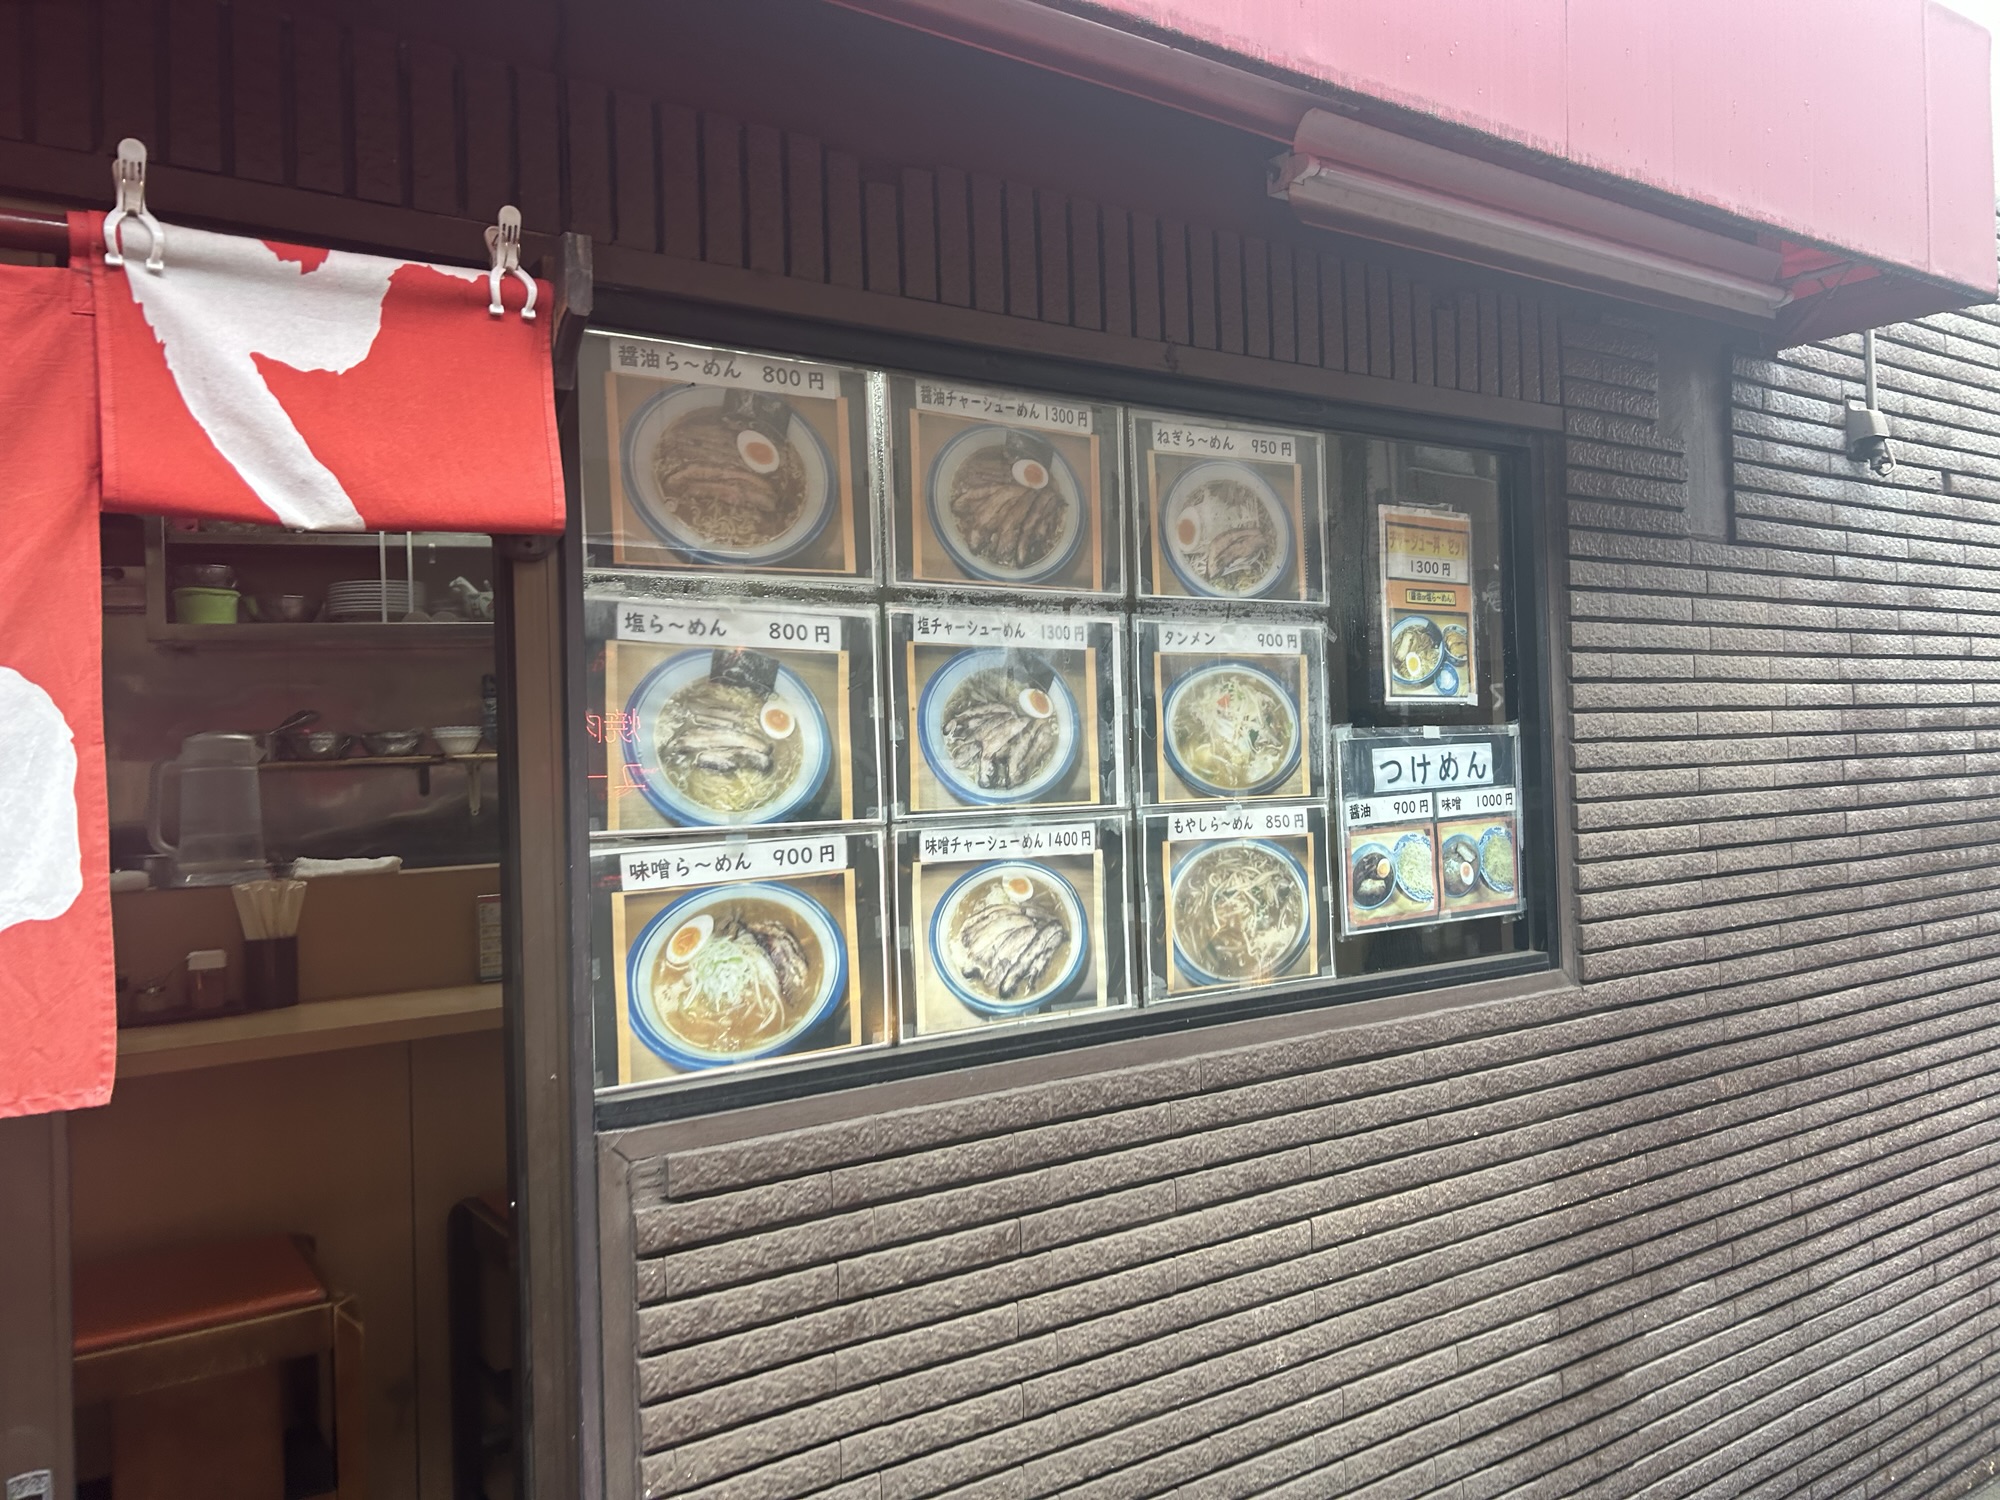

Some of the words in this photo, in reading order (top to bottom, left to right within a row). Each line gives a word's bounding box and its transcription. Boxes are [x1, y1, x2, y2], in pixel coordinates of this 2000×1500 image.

[618, 344, 742, 379] 醤油ら〜めん
[762, 365, 825, 391] 800円
[1156, 428, 1235, 451] ねぎら〜めん
[1251, 438, 1292, 457] 950円
[1410, 559, 1451, 577] 1300円
[624, 611, 727, 637] 塩ら〜めん
[768, 622, 830, 644] 800円
[917, 616, 1026, 639] 塩チャーシューめん
[1164, 630, 1216, 646] タンメン
[1257, 633, 1297, 649] 900円
[1379, 750, 1487, 785] つけめん
[1349, 804, 1371, 821] 醤油
[1393, 799, 1429, 815] 900円
[1441, 796, 1462, 812] 味噌
[1476, 792, 1513, 808] 1000円
[1174, 816, 1254, 834] もやしら〜めん
[1265, 813, 1304, 829] 850円
[925, 832, 1043, 856] 味噌チャーシューめん
[629, 852, 752, 882] 味噌ら〜めん
[772, 844, 836, 866] 900円
